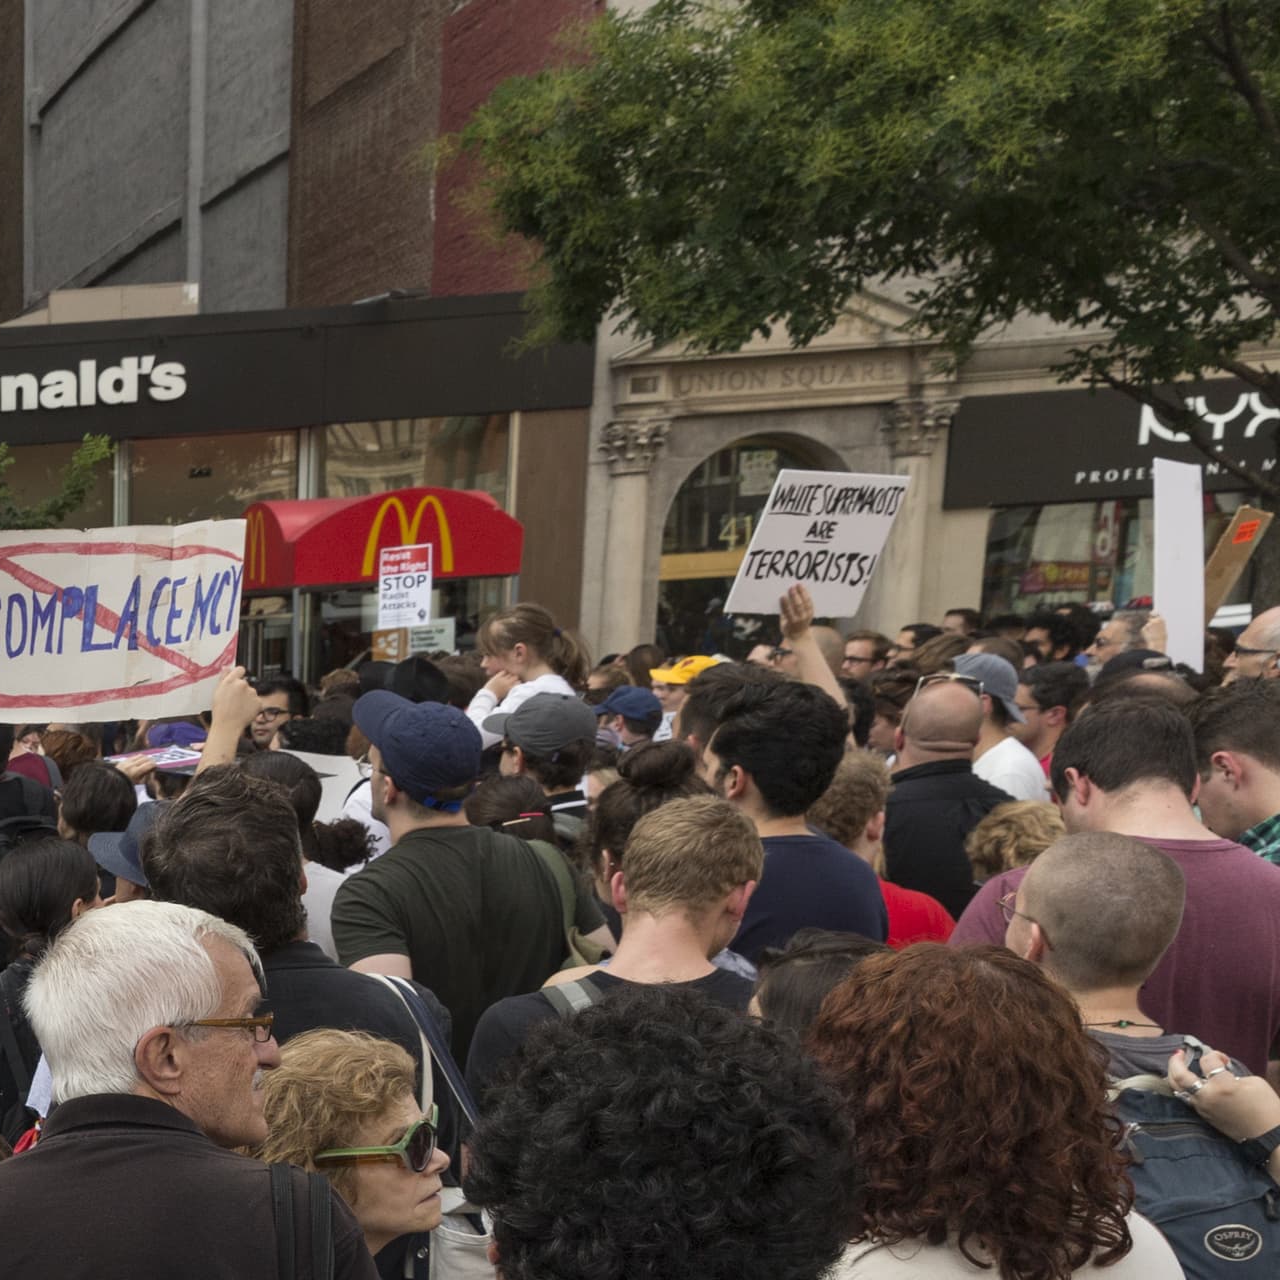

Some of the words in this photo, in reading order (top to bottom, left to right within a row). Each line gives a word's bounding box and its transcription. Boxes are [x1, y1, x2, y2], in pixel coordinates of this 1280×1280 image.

[678, 366, 770, 395] UNION
[782, 360, 896, 389] SQUARE
[771, 484, 823, 514] WHITE
[718, 515, 752, 552] 41
[806, 520, 838, 540] ARE
[383, 574, 427, 591] STOP
[745, 550, 877, 586] TERRORISTS!
[1214, 1231, 1253, 1241] OSPREY
